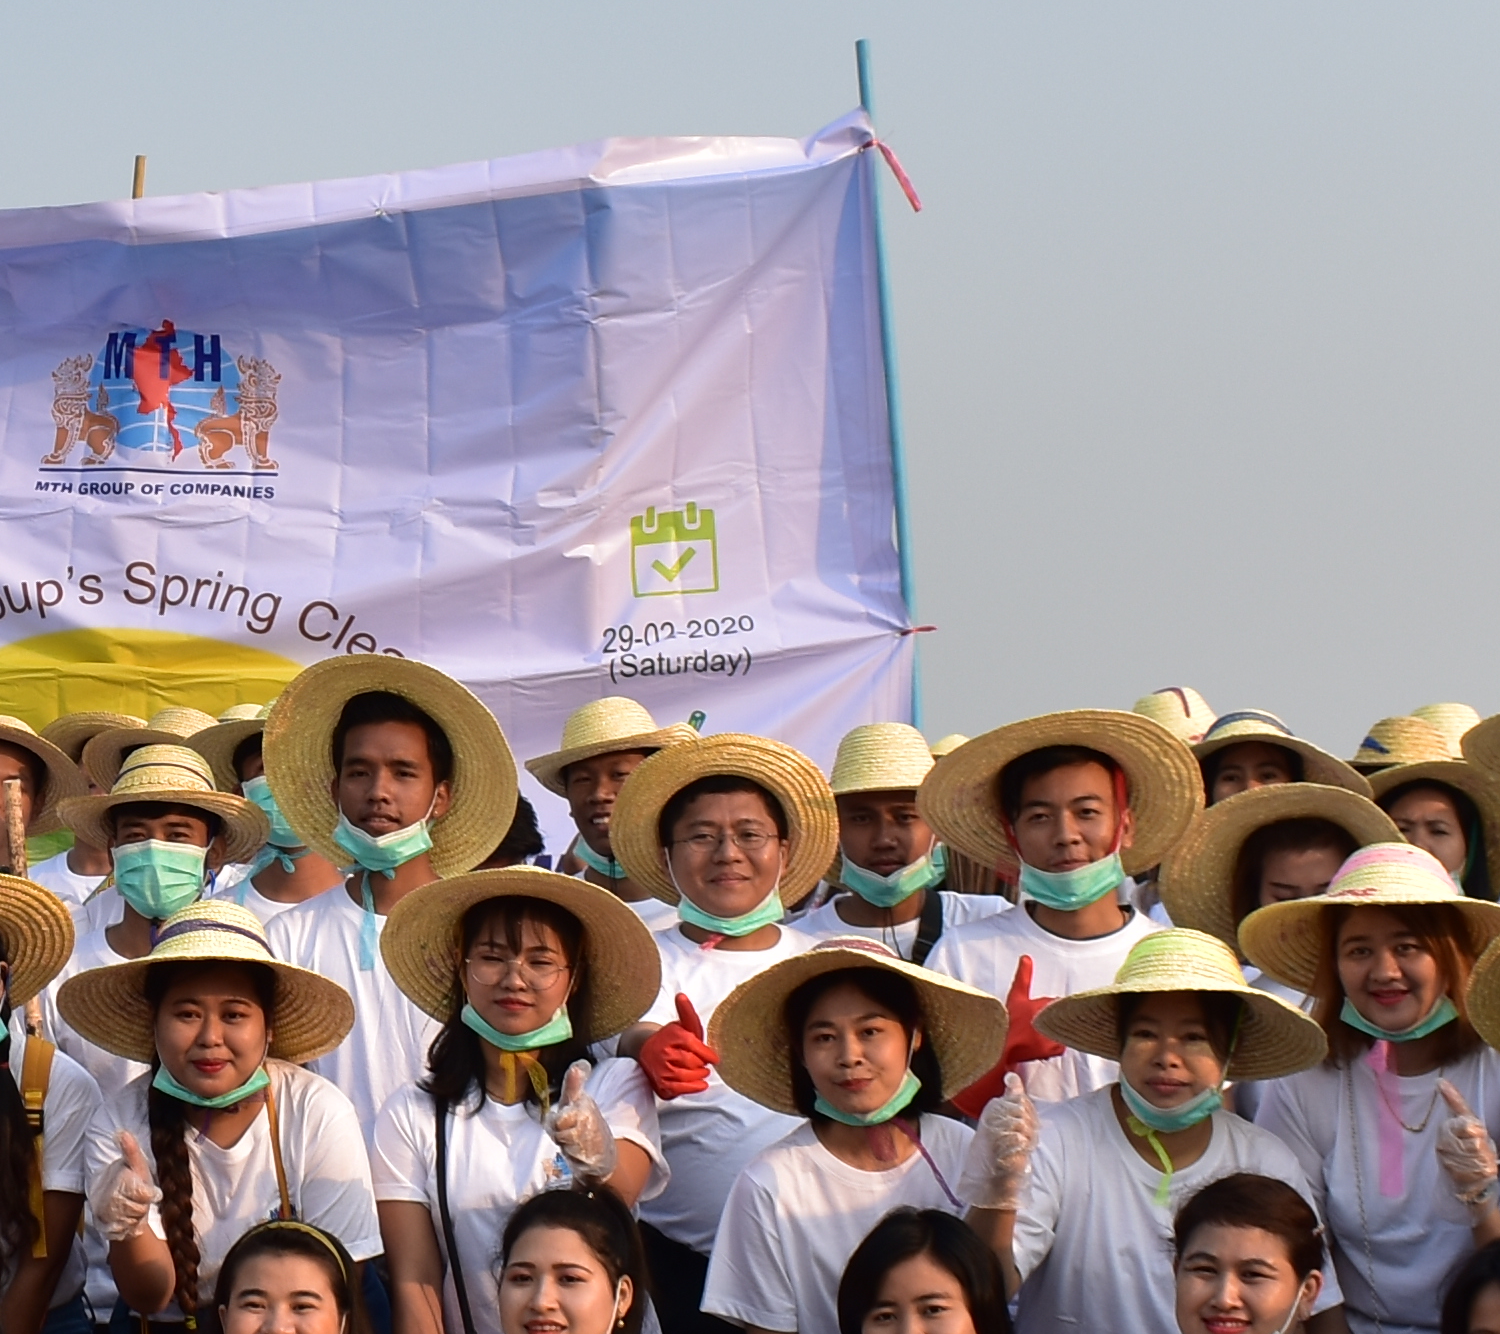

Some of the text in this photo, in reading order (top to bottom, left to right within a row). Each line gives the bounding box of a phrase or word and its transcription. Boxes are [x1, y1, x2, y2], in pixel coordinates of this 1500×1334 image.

[103, 332, 221, 383] MTH
[34, 480, 275, 499] MTH GROUP OF COMPANIES
[123, 560, 283, 635] Spring
[602, 614, 755, 654] 29-02-2020
[610, 646, 753, 685] (Saturday)
